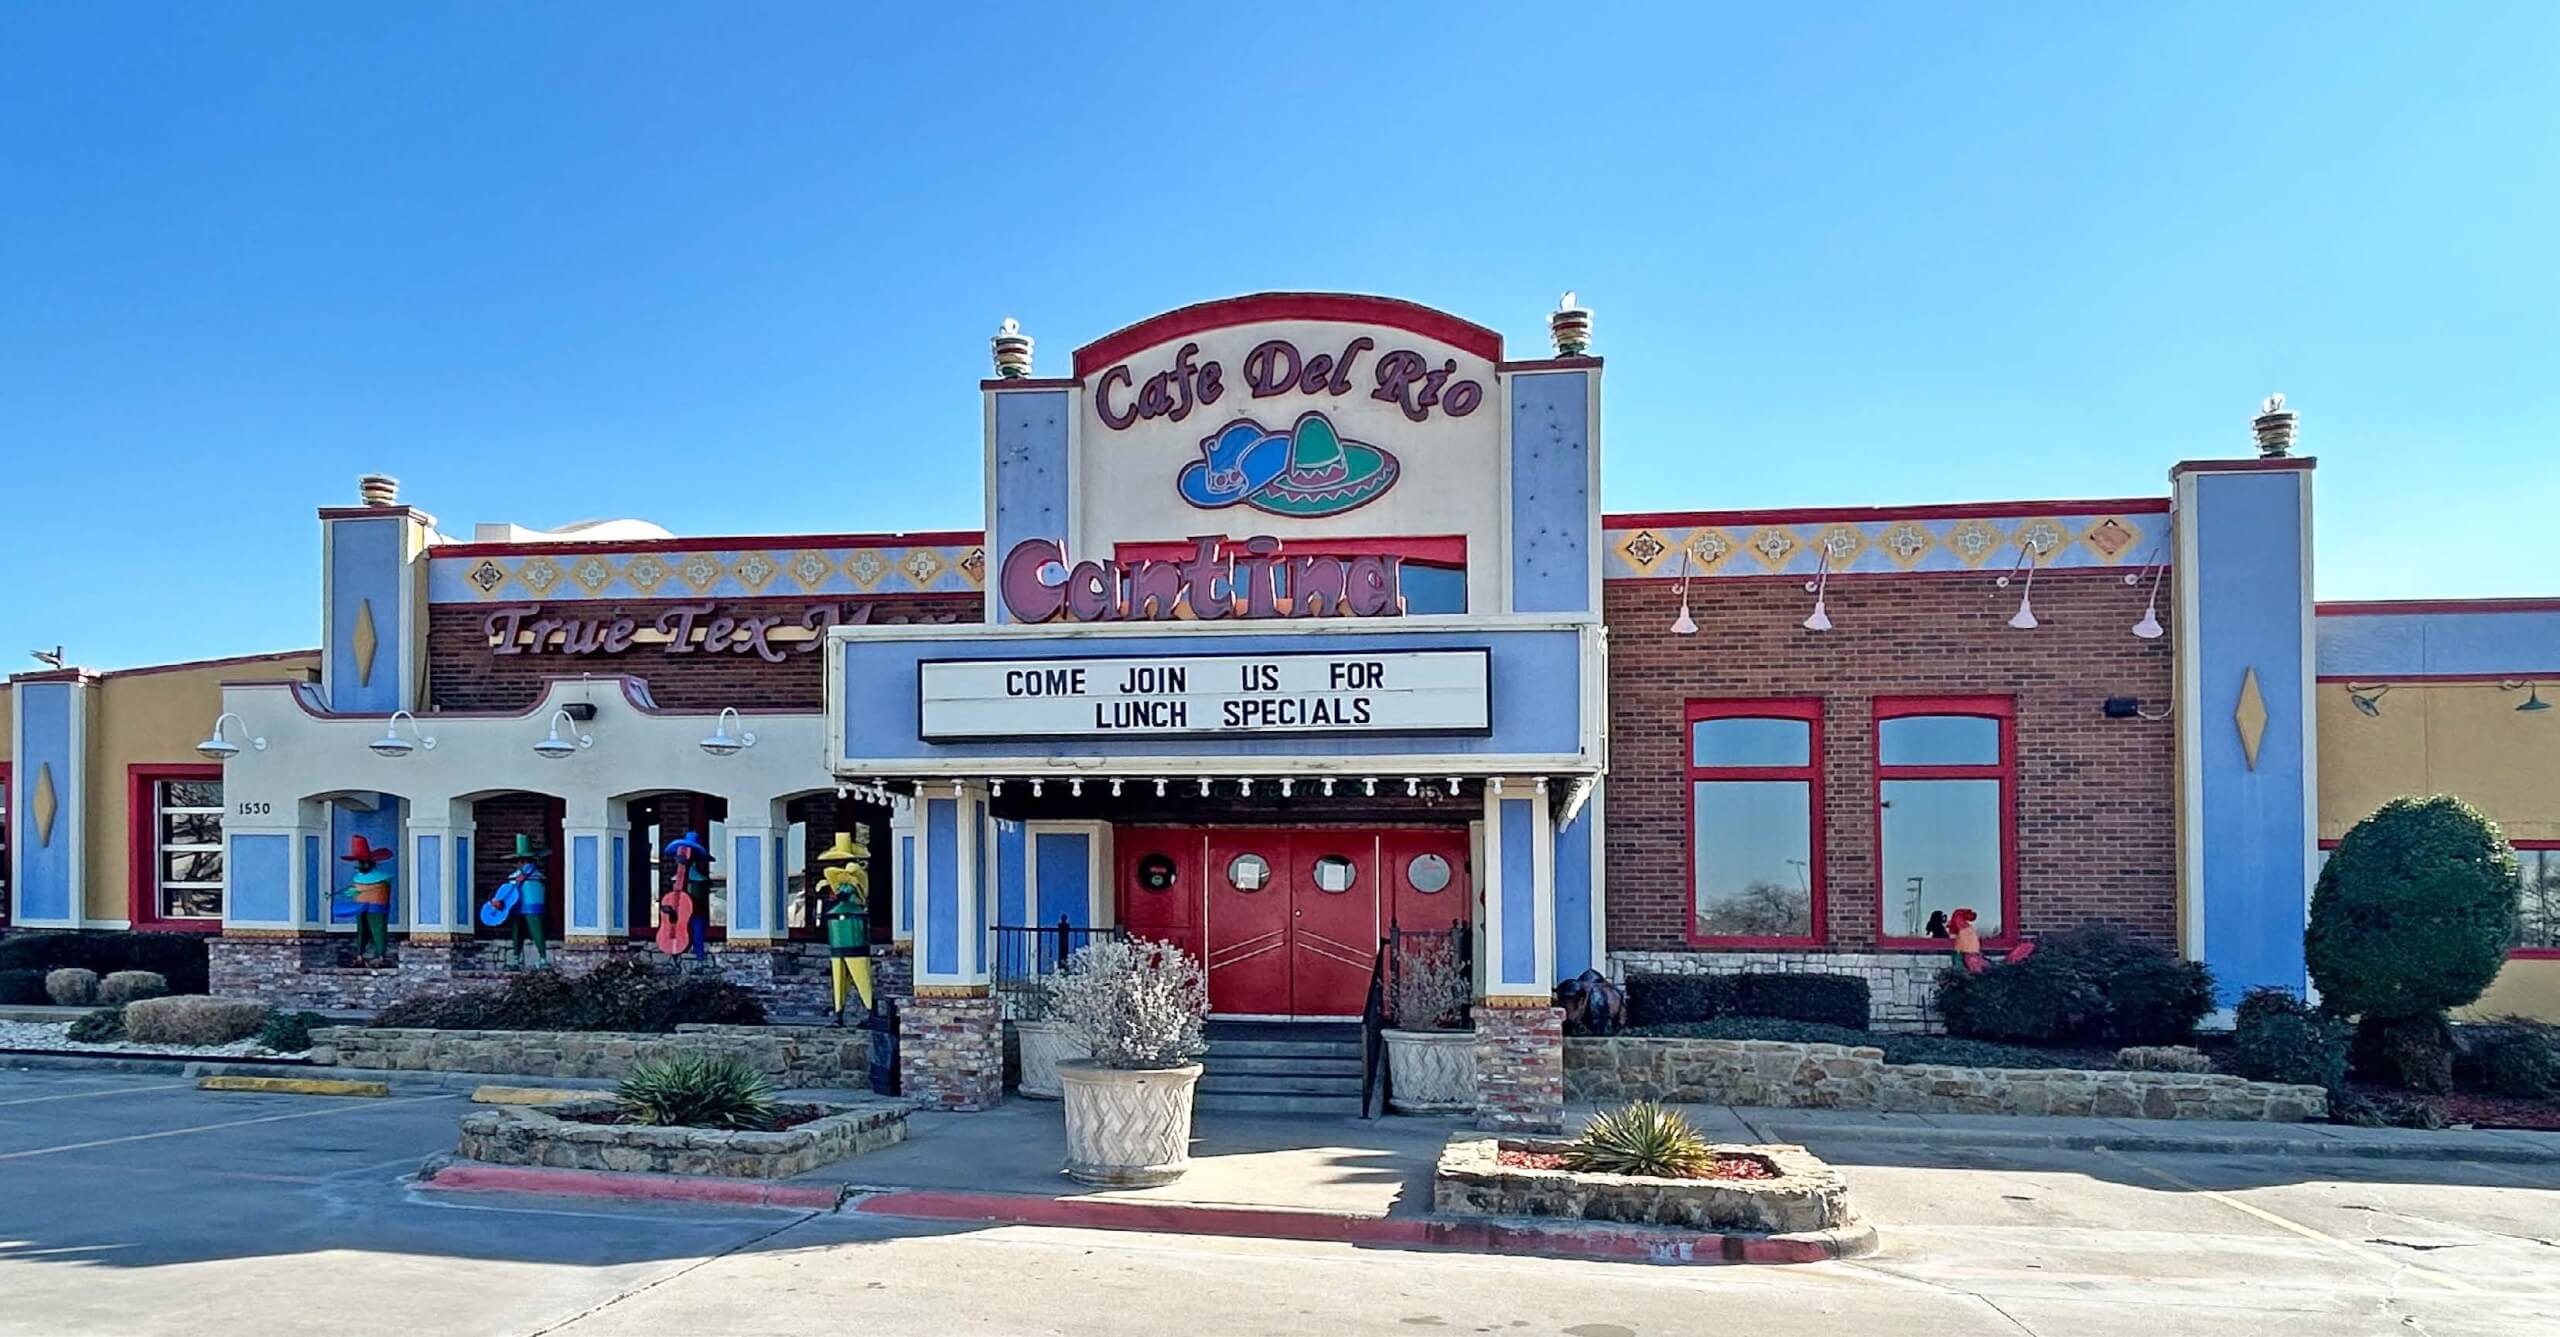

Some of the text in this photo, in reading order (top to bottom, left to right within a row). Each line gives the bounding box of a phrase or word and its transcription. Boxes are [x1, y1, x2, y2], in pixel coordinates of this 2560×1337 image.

[1096, 337, 1483, 431] Cafe Del Rio
[1000, 534, 1406, 624] Cantina
[483, 604, 636, 656] True
[656, 602, 786, 663] Tex
[1006, 662, 1384, 696] COME JOIN US FOR
[1096, 698, 1372, 729] LUNCH SPECIALS
[239, 802, 270, 815] 1530
